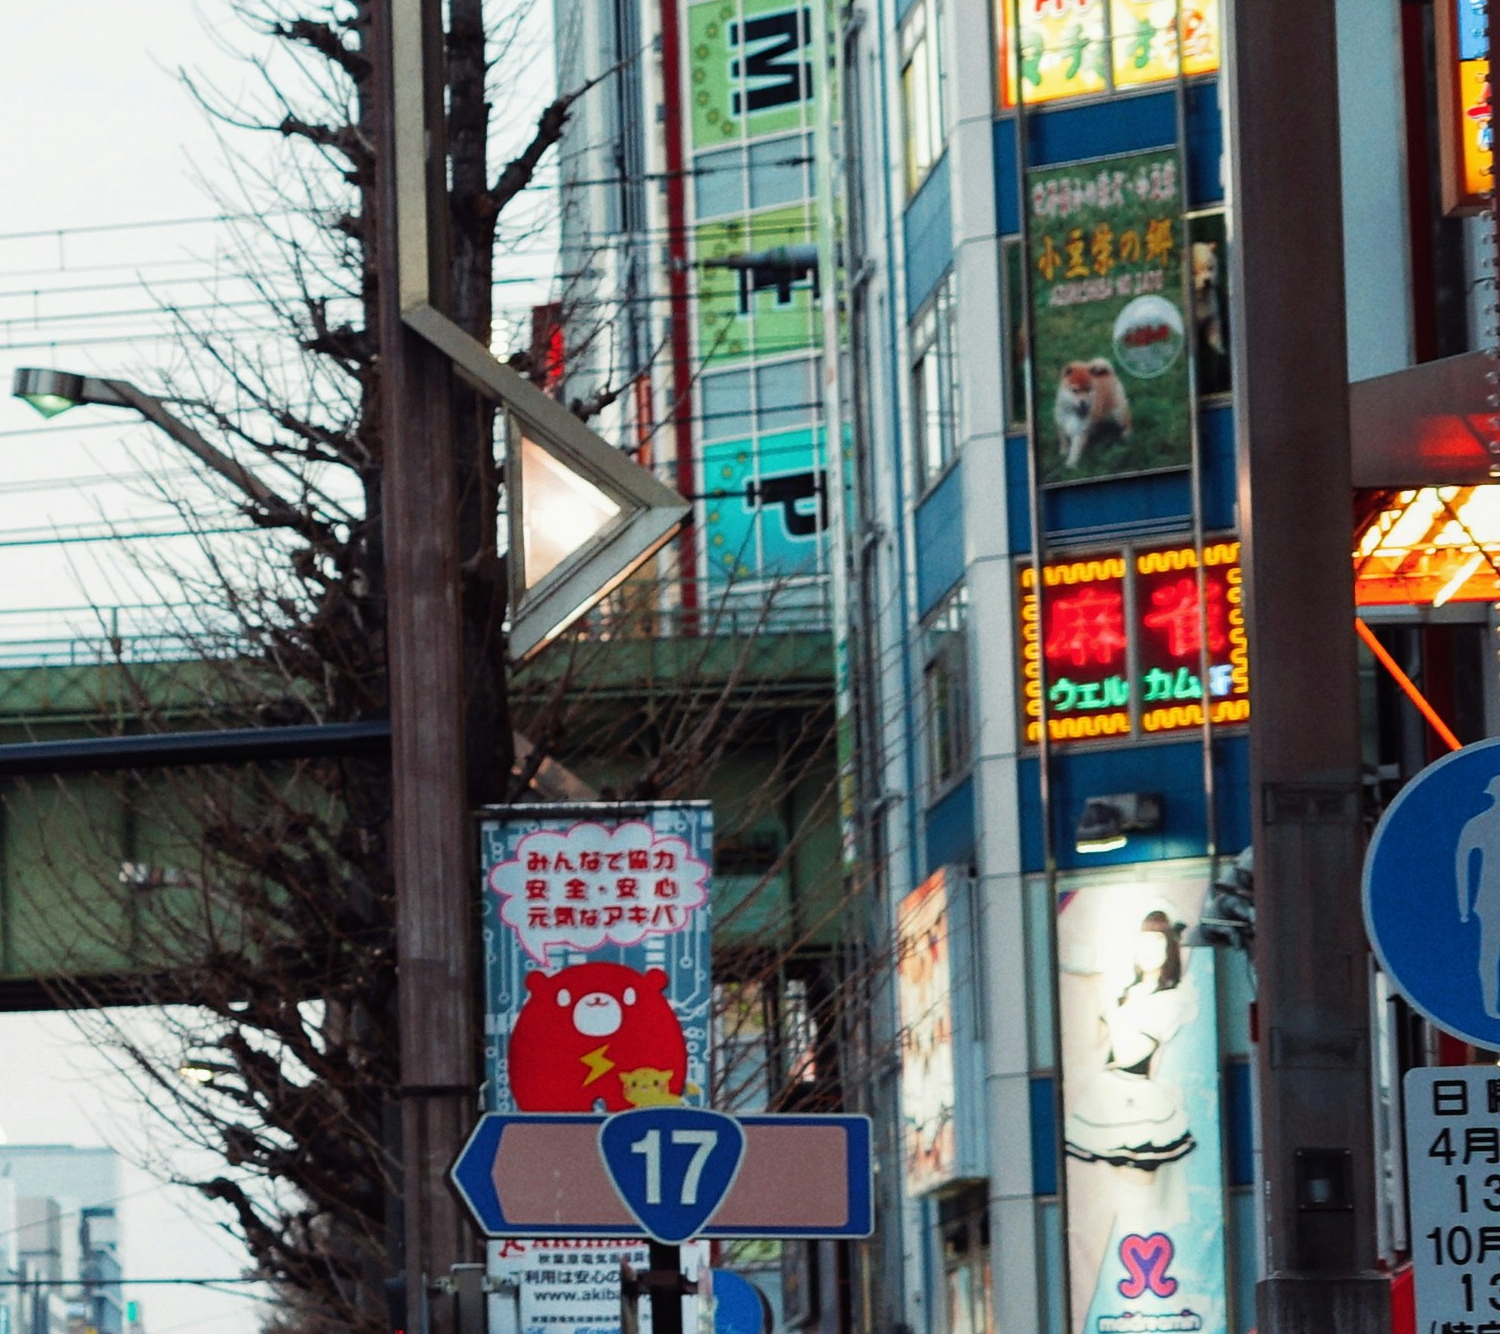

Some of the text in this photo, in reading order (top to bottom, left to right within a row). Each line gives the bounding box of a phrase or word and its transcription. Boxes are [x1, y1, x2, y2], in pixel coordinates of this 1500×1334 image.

[1045, 578, 1225, 669] 麻雀
[1048, 667, 1202, 712] ウェルカム
[526, 849, 677, 875] みんなで協力
[526, 877, 680, 900] 安全・安心
[527, 904, 676, 929] 元気なアキバ
[629, 1128, 720, 1208] 17
